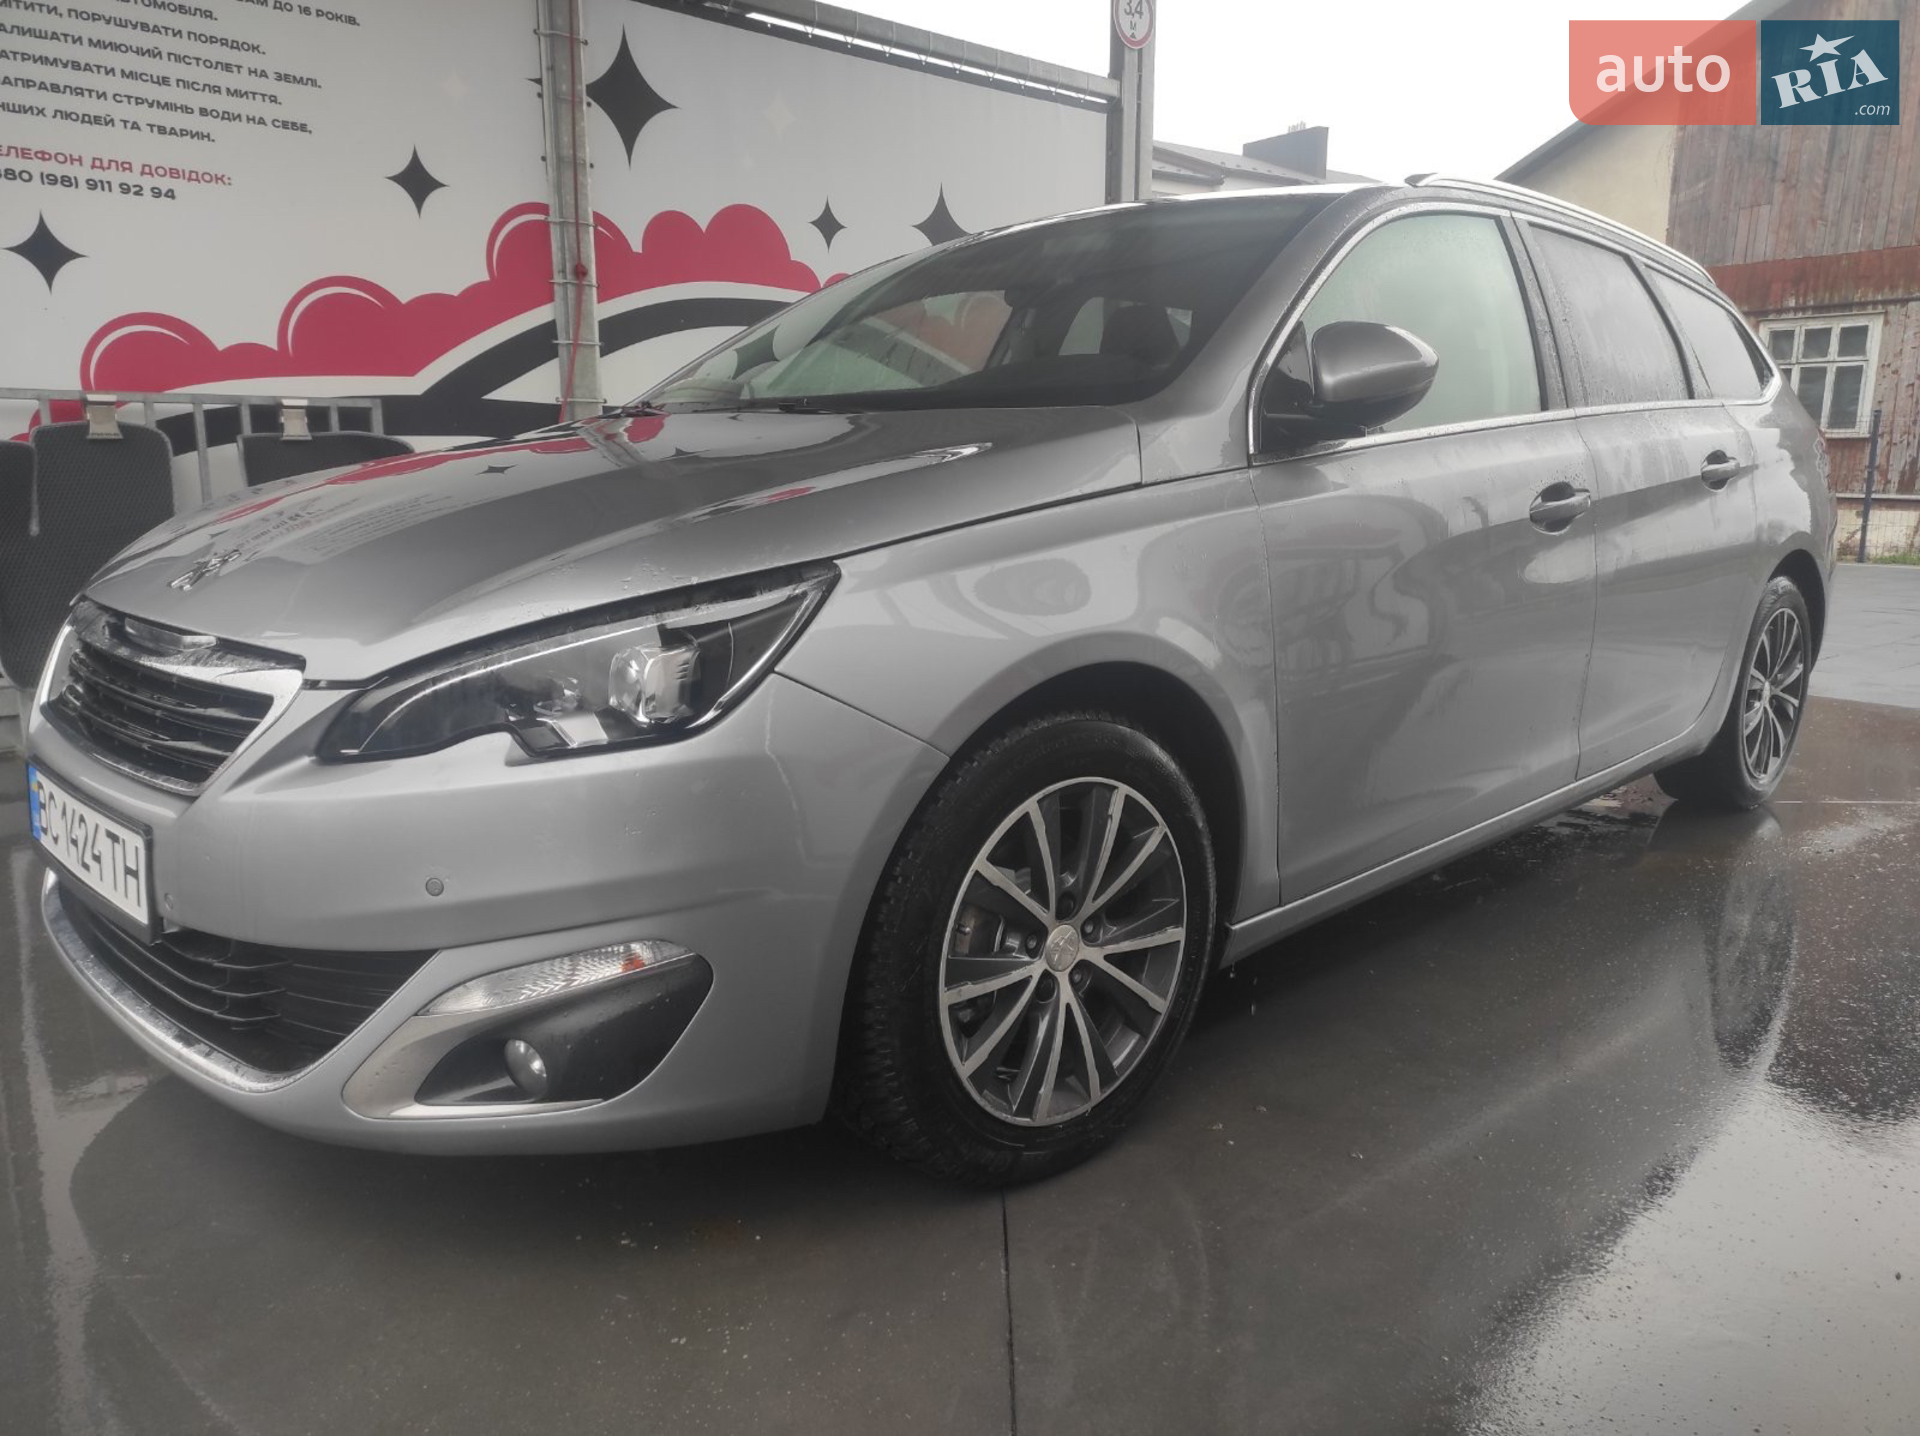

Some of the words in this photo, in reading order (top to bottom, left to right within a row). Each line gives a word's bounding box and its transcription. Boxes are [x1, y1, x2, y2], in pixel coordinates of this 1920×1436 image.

[67, 8, 183, 39] ПОРУШУВАТИ
[187, 31, 266, 55] ПОРЯДОК.
[273, 0, 294, 12] ДО
[298, 4, 312, 16] 16
[315, 9, 361, 26] РОКІВ.
[88, 38, 163, 60] МИЮЧИЙ
[167, 52, 243, 74] ПІСТОЛЕТ
[247, 67, 269, 79] НА
[273, 71, 322, 89] ЗЕМЛІ.
[1, 75, 108, 101] АПРАВЛЯТИ
[112, 93, 195, 115] СТРУМІНЬ
[199, 107, 242, 122] ВОДИ
[246, 114, 267, 126] НА
[271, 118, 312, 134] СЕБЕ,
[120, 68, 172, 87] МІСЦЕ
[176, 78, 222, 95] ПІСЛЯ
[226, 87, 282, 105] МИТТЯ.
[52, 109, 115, 127] ЛЮДЕЙ
[119, 119, 142, 132] ТА
[146, 123, 216, 142] ТВАРИН.
[0, 145, 83, 167] ЛЕФОН
[90, 157, 133, 173] ДЛЯ
[140, 163, 233, 186] ДОВІДОК:
[0, 168, 33, 183] 80
[40, 171, 79, 189] (98)
[85, 178, 113, 193] 911
[119, 182, 144, 196] 92
[150, 186, 176, 200] 94
